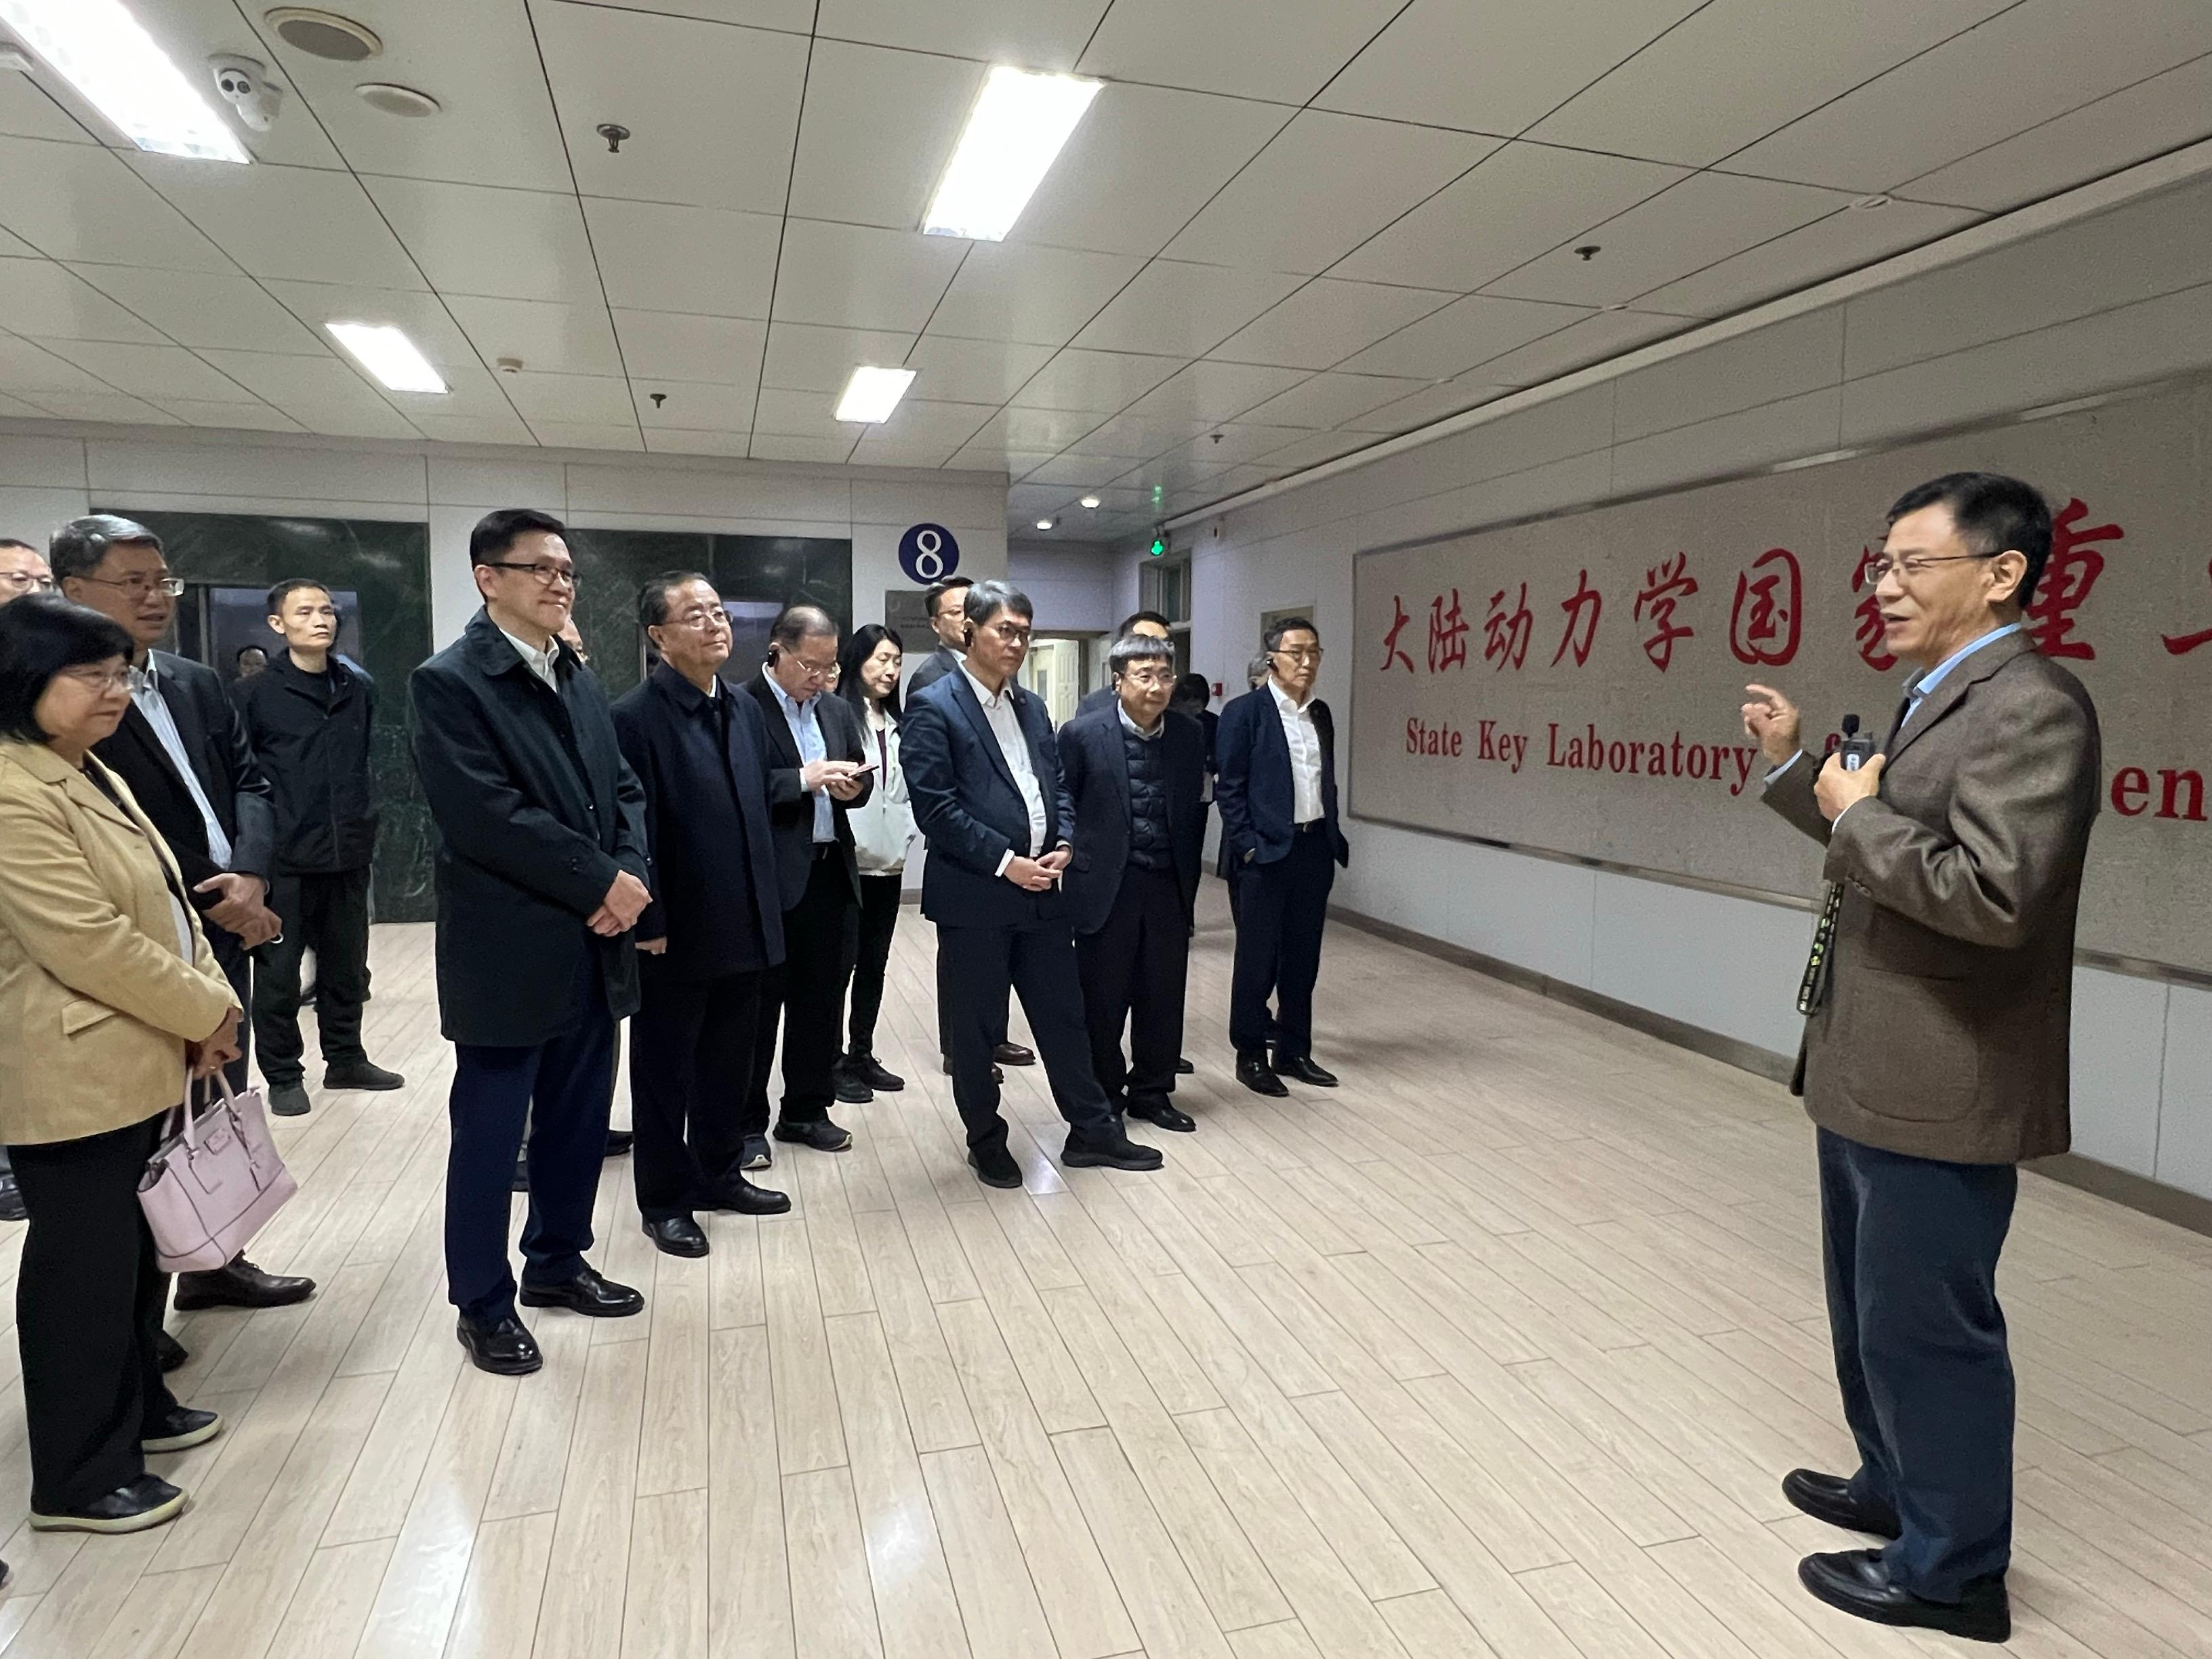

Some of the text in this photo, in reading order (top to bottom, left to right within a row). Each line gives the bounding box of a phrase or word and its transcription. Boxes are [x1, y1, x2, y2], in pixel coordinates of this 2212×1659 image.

[916, 530, 943, 579] 8
[1406, 717, 1462, 758] State
[1477, 720, 1528, 773] Key
[1547, 723, 1758, 796] Laboratory
